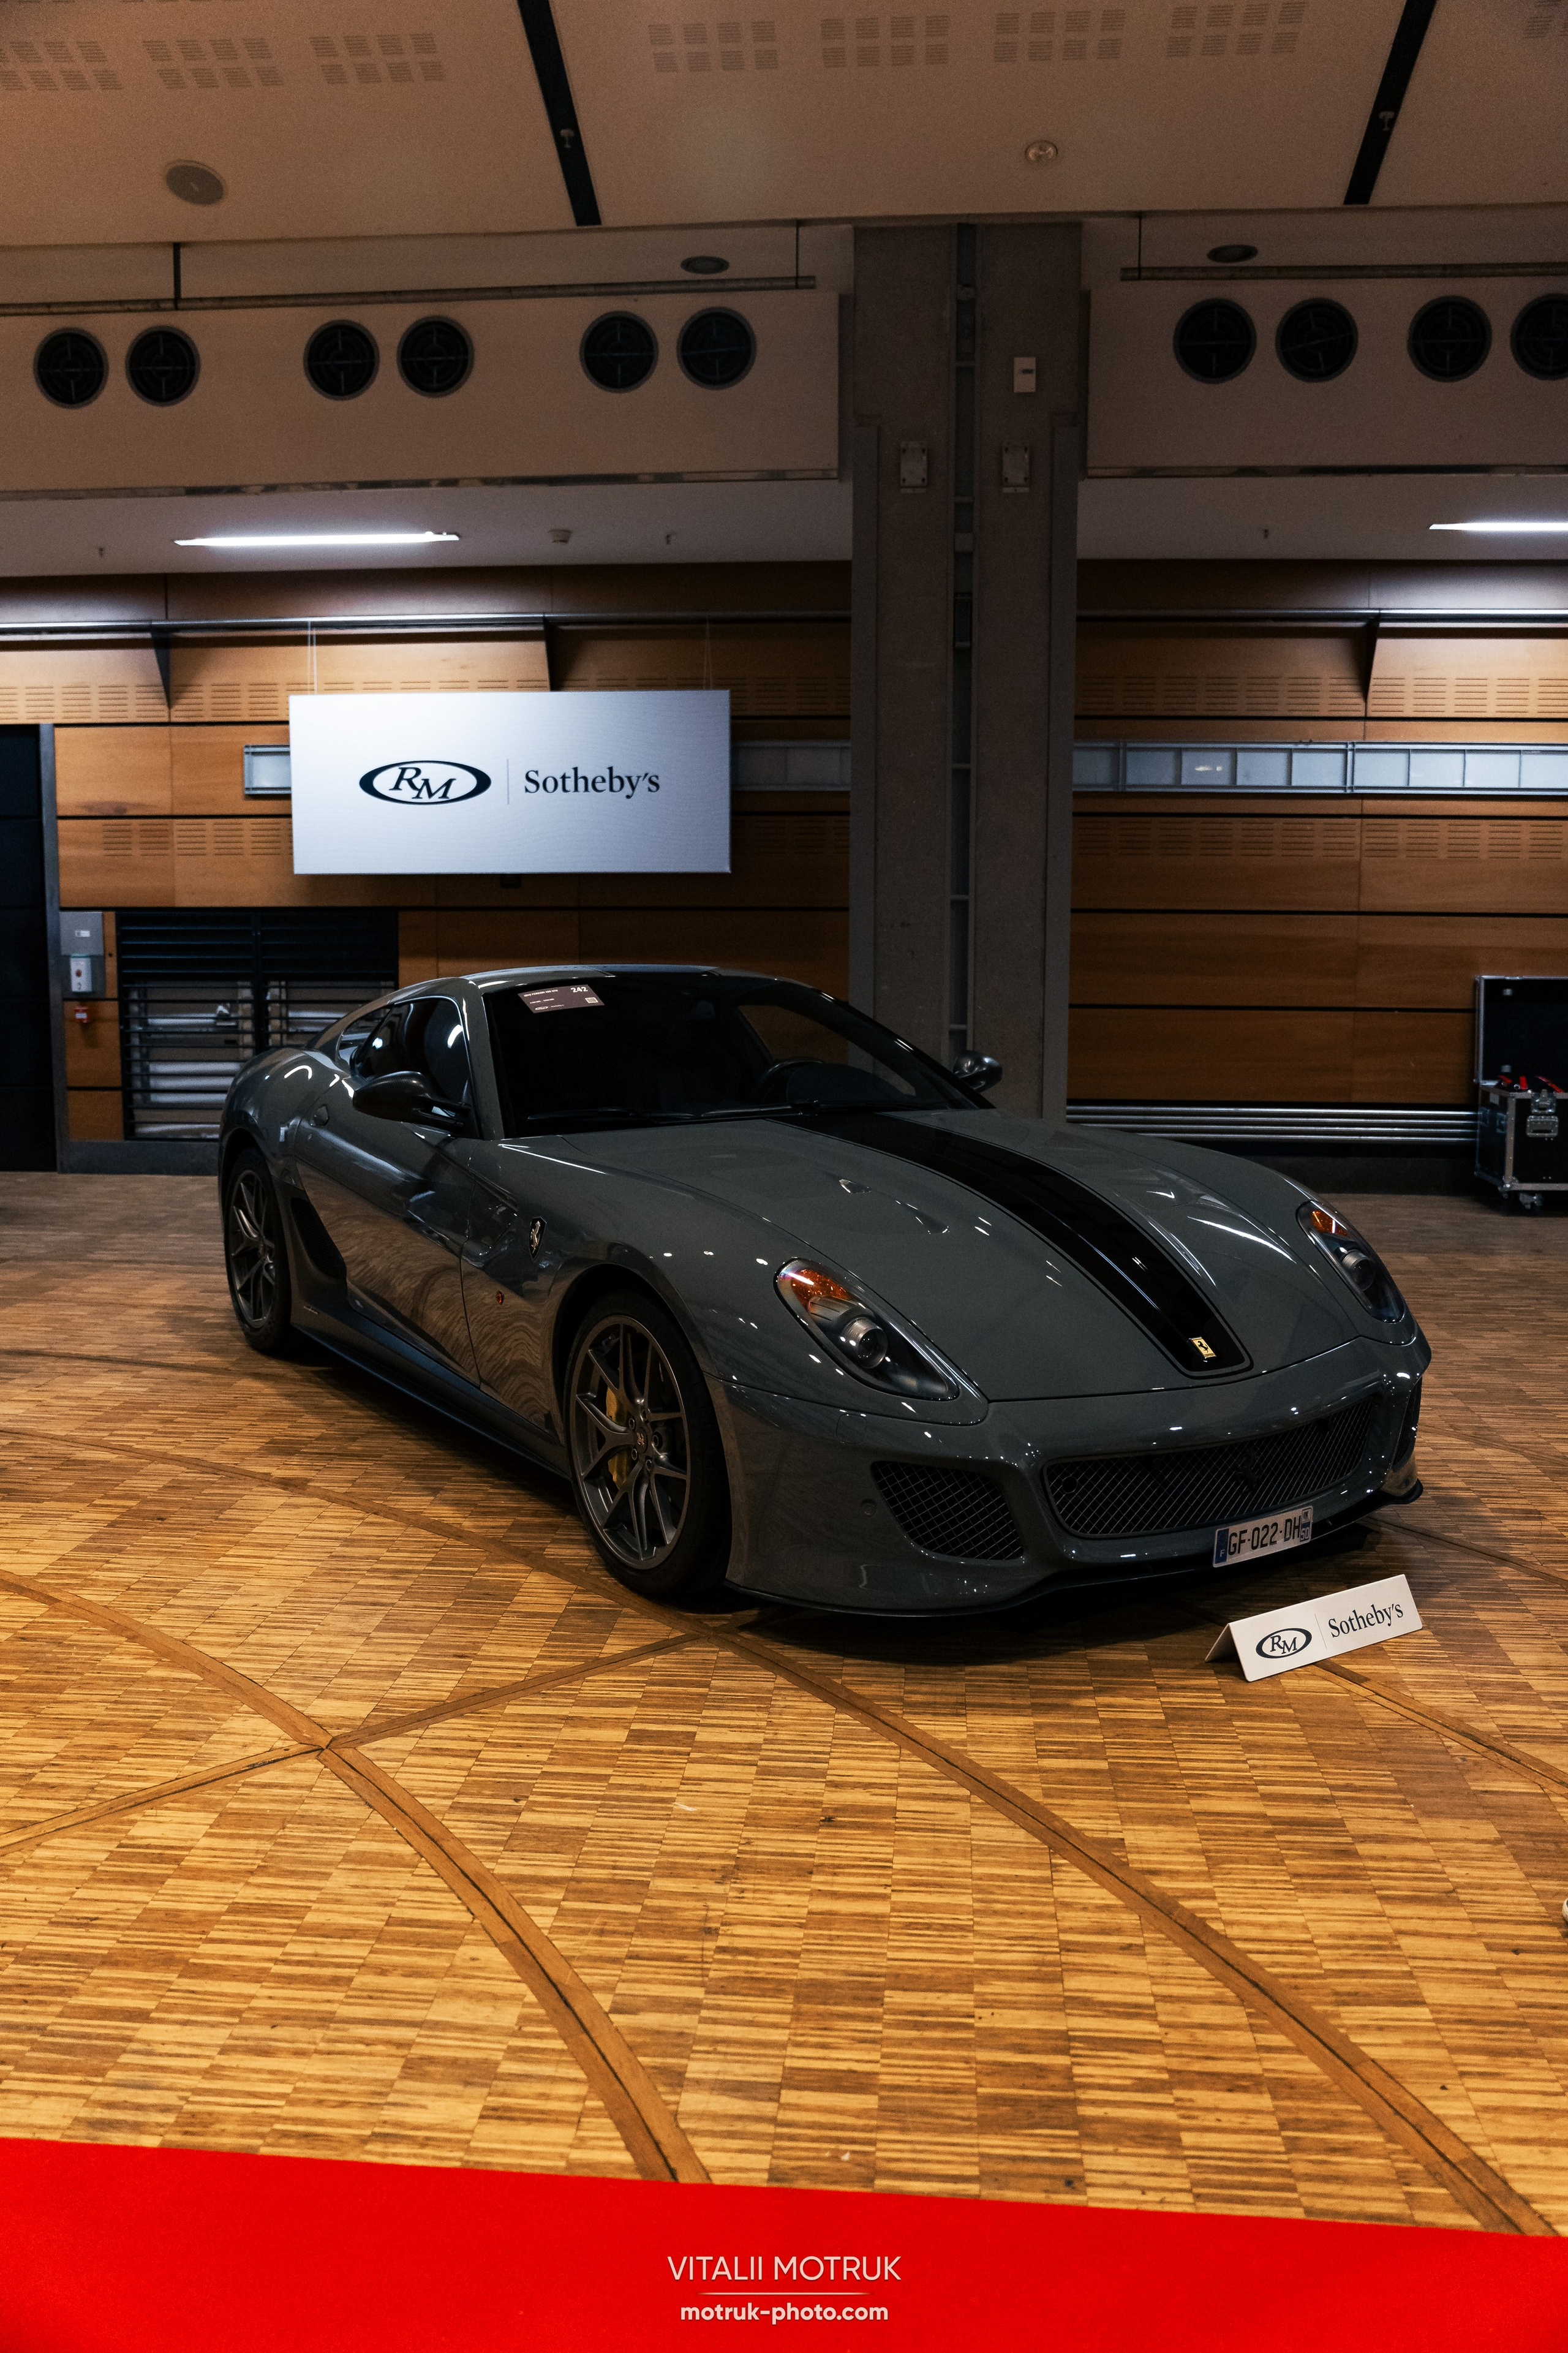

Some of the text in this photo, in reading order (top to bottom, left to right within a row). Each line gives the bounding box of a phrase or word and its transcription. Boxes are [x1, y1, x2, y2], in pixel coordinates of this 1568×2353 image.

[389, 766, 660, 800] RM Sotheby's
[1228, 1516, 1301, 1555] GF-022-DH
[1300, 1527, 1310, 1541] 50
[1270, 1603, 1404, 1654] RM Sotheby's
